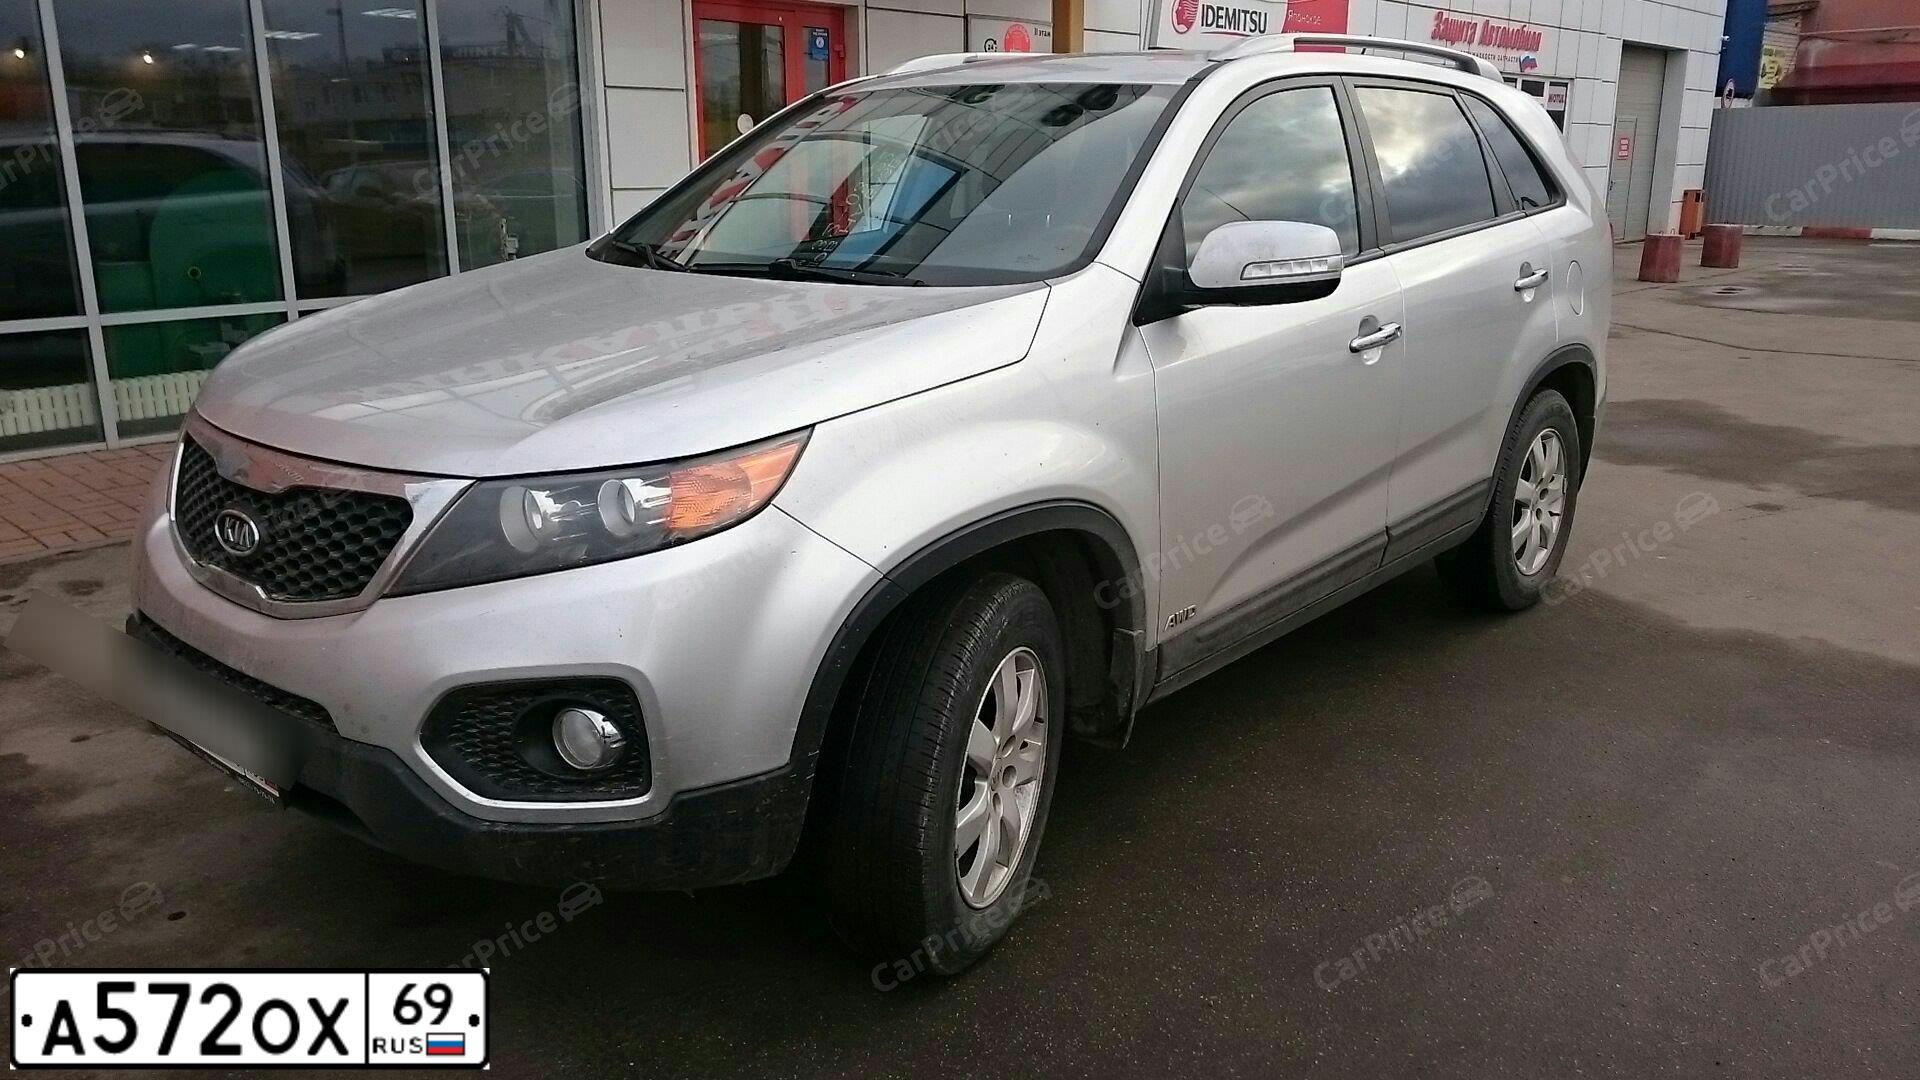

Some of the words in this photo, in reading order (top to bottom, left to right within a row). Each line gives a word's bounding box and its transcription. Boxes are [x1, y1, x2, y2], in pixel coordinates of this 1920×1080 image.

[1201, 3, 1268, 34] IDEMITSU
[1430, 11, 1478, 45] Защита
[1478, 19, 1543, 52] Автомобиля
[223, 516, 252, 548] KIA
[1164, 604, 1197, 631] AWD
